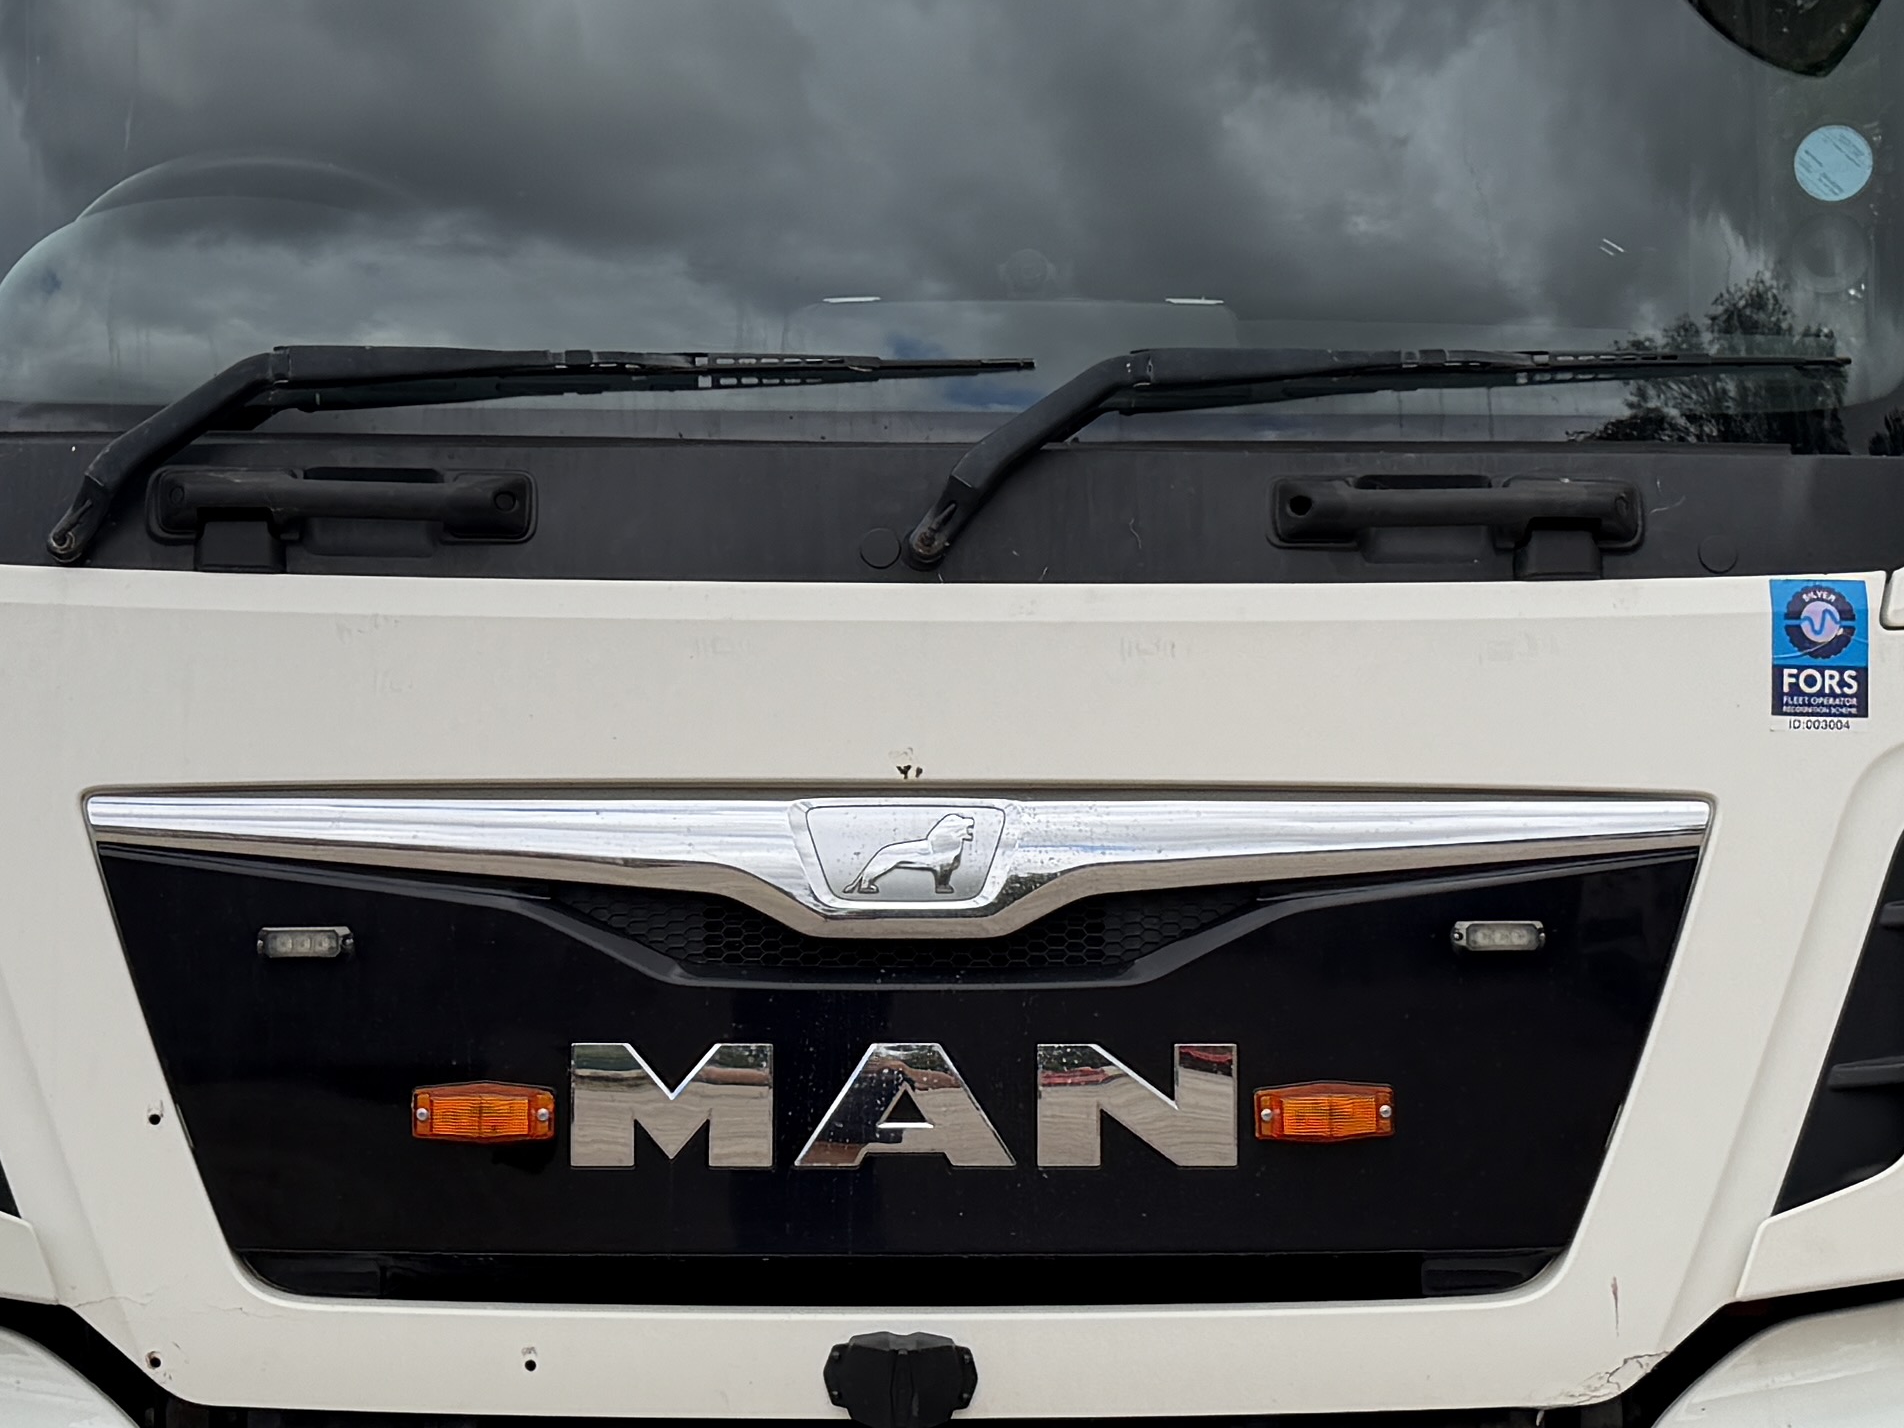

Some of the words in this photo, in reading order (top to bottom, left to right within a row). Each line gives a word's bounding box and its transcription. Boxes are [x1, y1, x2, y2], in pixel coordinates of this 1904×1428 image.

[1782, 668, 1859, 695] FORS
[1783, 696, 1809, 706] FLEET
[1810, 696, 1858, 706] OPERATOR
[569, 1042, 1239, 1170] MAN
